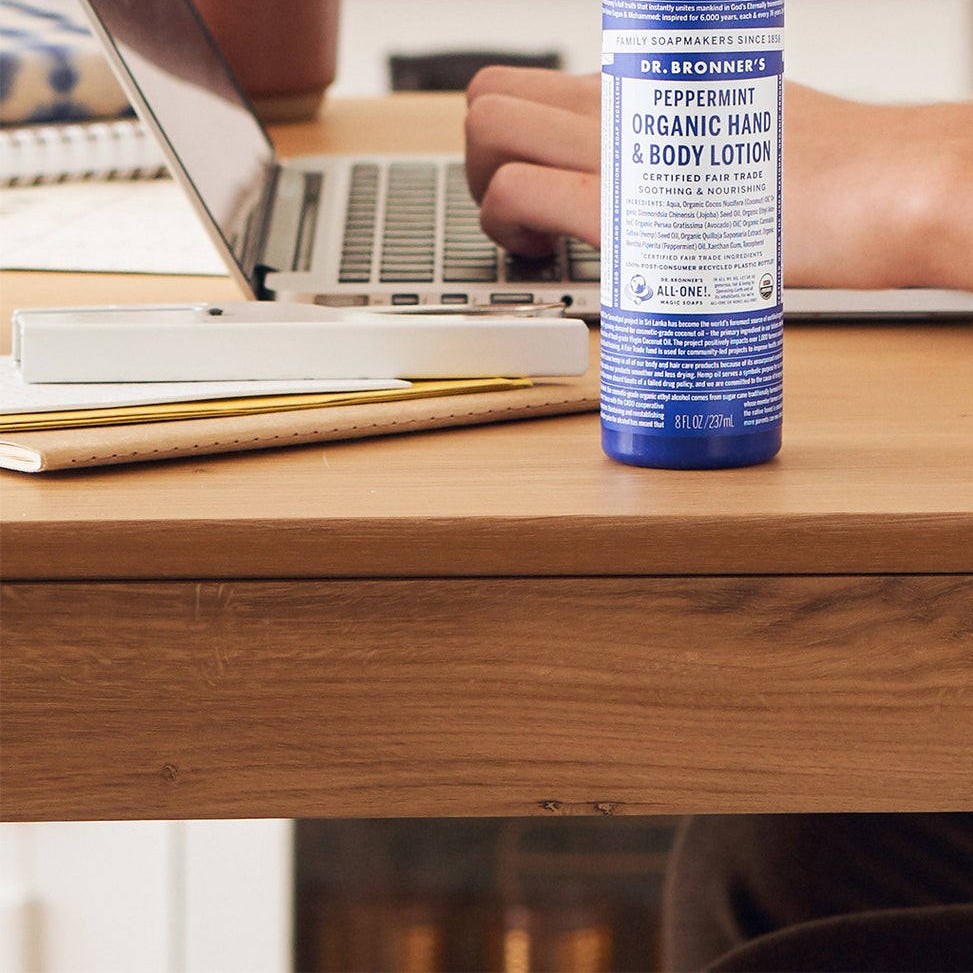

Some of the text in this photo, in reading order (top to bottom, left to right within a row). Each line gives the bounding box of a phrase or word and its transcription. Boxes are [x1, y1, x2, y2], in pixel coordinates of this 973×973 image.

[649, 4, 674, 12] instantly
[616, 34, 781, 46] FAMILY SOAPMAKERS SINCE 1858
[641, 58, 766, 74] DR. BRONNER'S
[654, 88, 755, 107] PEPPERMINT
[632, 111, 771, 136] ORGANIC HAND
[615, 149, 620, 159] OF
[632, 140, 770, 166] & BODY LOTION
[643, 173, 700, 182] CERTIFIED
[734, 171, 762, 180] TRADE
[639, 186, 692, 195] SOOTHING
[708, 184, 766, 194] NOURISHING
[675, 415, 680, 429] 8
[682, 415, 691, 428] FL
